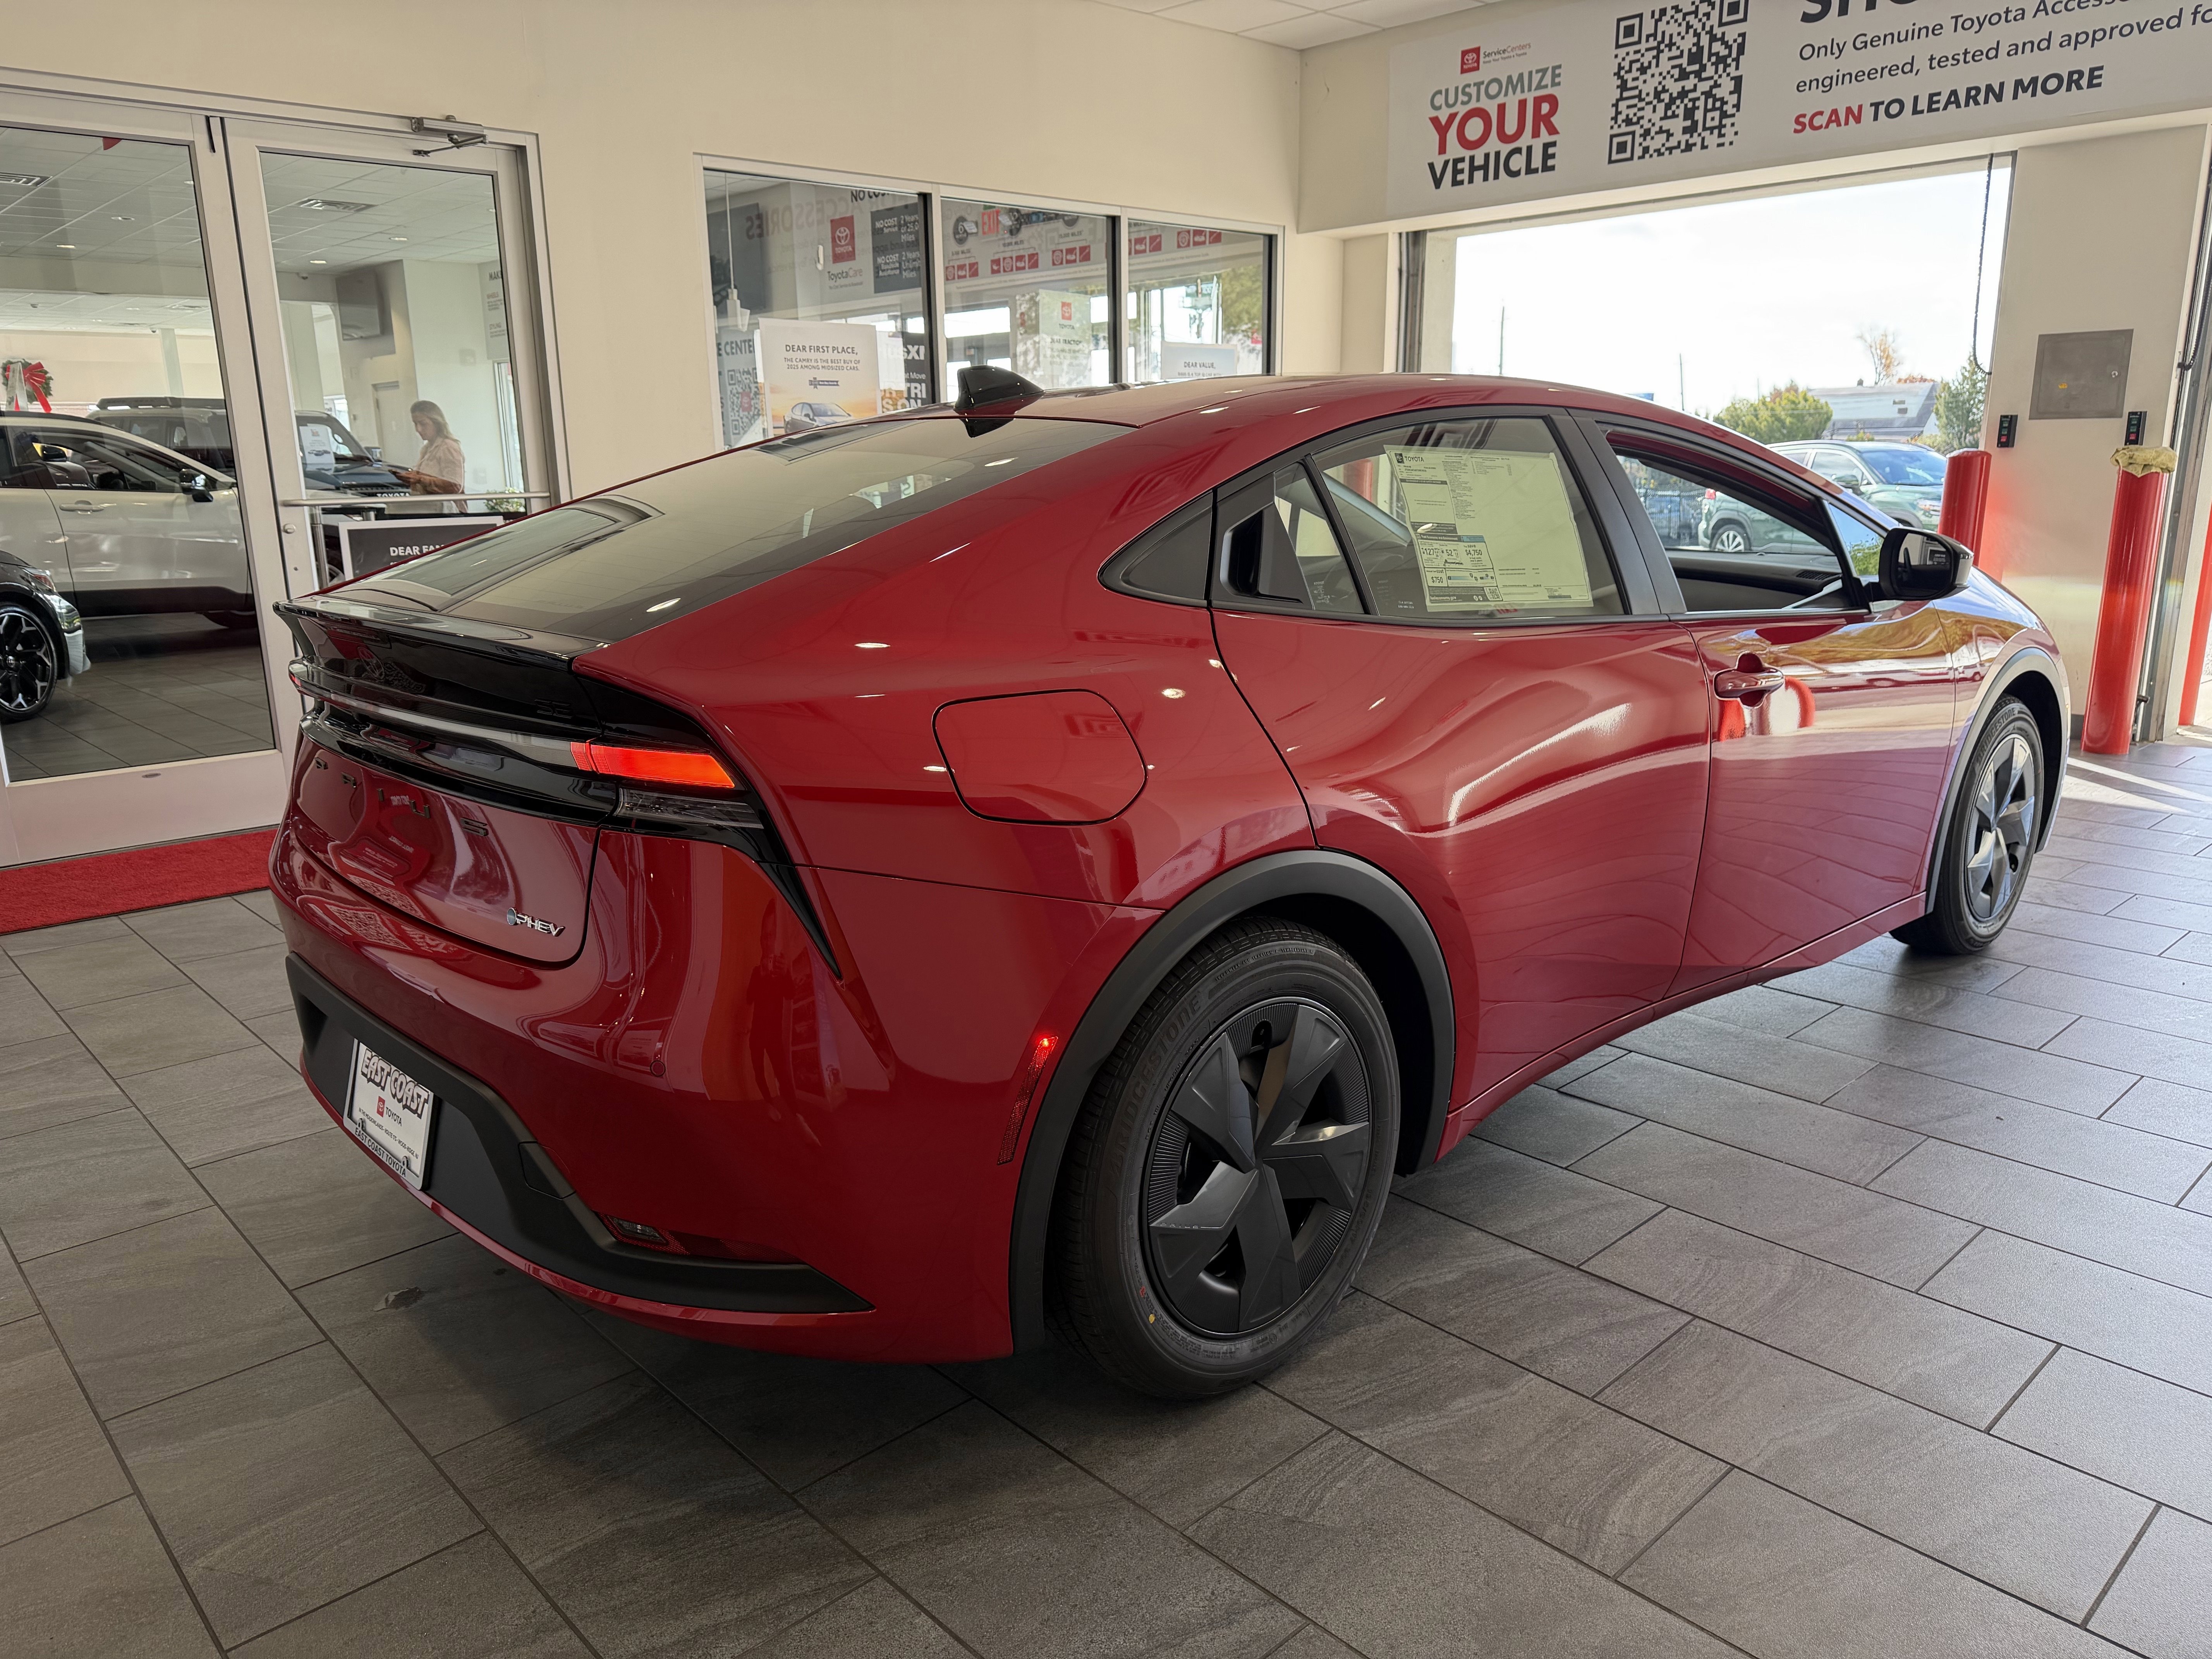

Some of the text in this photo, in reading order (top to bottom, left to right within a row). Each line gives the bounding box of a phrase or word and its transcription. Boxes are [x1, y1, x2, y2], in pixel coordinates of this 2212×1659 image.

[1483, 42, 1531, 58] ServiceCenters
[1796, 55, 1920, 93] engineered,
[1928, 40, 2001, 70] tested
[2006, 31, 2052, 57] and
[2059, 7, 2183, 51] approved
[1799, 38, 1847, 60] Only
[1852, 22, 1944, 51] Genuine
[1951, 6, 2025, 34] Toyota
[1430, 64, 1562, 111] CUSTOMIZE
[1793, 65, 2104, 134] SCAN TO LEARN MORE
[1428, 93, 1560, 155] YOUR
[1427, 140, 1557, 189] VEHICLE
[875, 217, 897, 228] NO COST
[828, 268, 862, 282] ToyotaCare
[785, 344, 807, 352] DEAR
[832, 346, 858, 355] PLACE,
[390, 546, 421, 556] DEAR
[314, 757, 489, 836] PRIUS
[516, 912, 566, 937] PHEV
[1252, 950, 1273, 961] TRACTION
[361, 1048, 429, 1119] EAST COAST
[1109, 994, 1201, 1176] BRIDGESTONE
[385, 1128, 393, 1139] ROUTE
[386, 1107, 402, 1127] TOYOTA
[355, 1127, 406, 1178] EAST COAST TOYOTA
